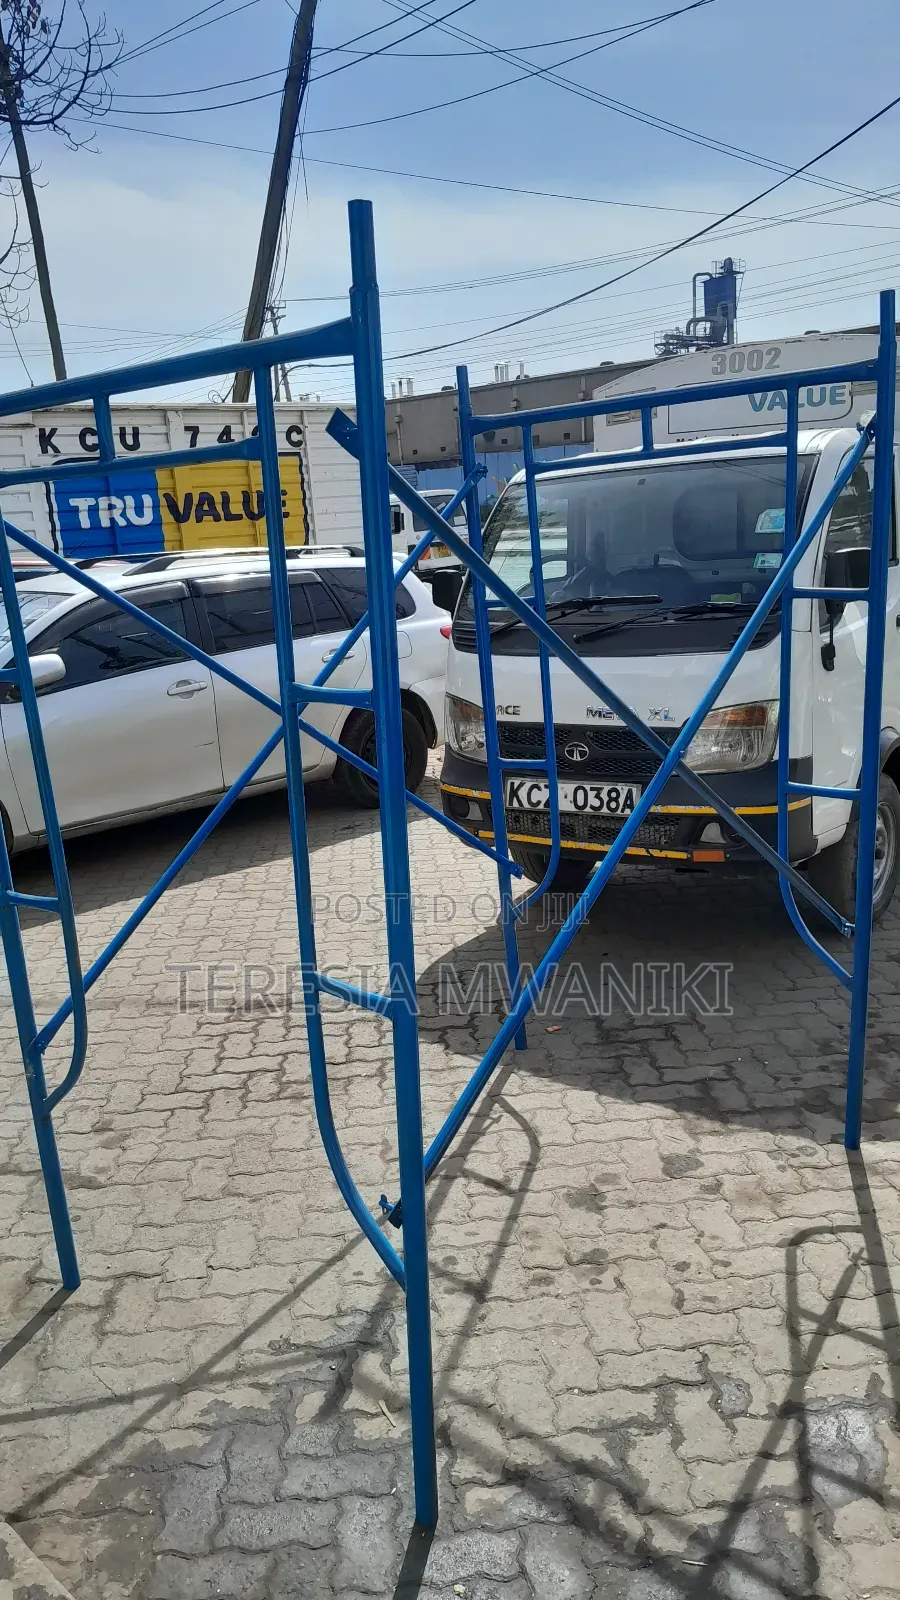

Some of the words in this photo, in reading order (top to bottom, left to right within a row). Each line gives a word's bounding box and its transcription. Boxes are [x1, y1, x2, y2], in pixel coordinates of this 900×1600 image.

[711, 347, 782, 376] 3002
[183, 425, 304, 448] 74C
[69, 494, 153, 529] TRU
[586, 704, 641, 722] ME
[647, 706, 675, 722] XL
[572, 785, 636, 814] 038A
